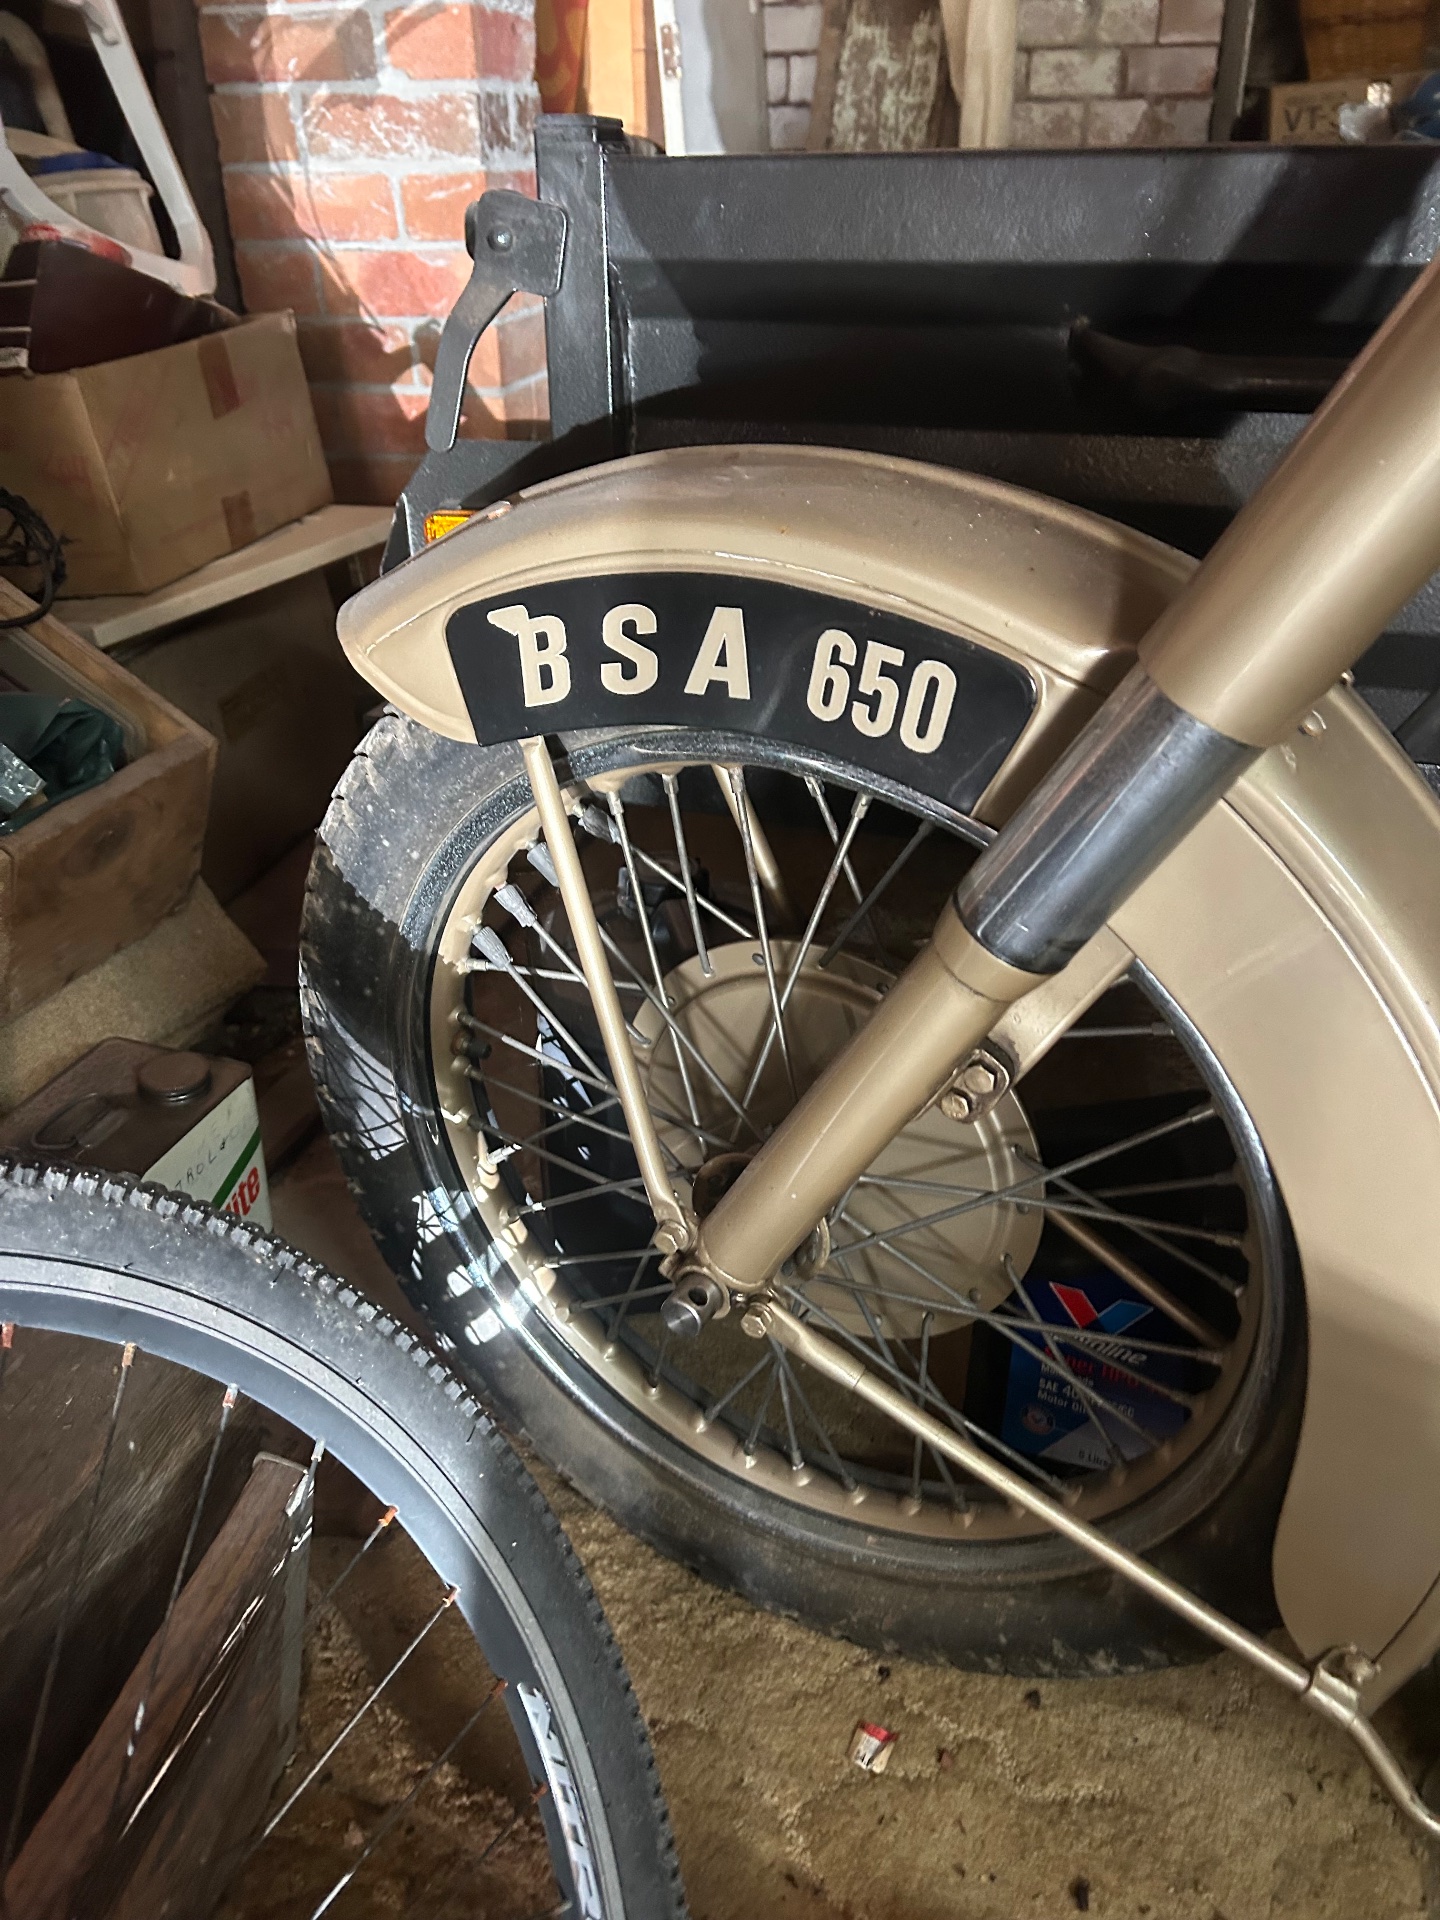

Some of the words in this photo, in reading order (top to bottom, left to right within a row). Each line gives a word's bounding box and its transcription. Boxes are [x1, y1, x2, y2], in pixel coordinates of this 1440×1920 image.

[805, 628, 958, 755] 650
[225, 1166, 260, 1216] ite
[1037, 1390, 1069, 1408] Motor
[516, 1682, 602, 1920] NITR
